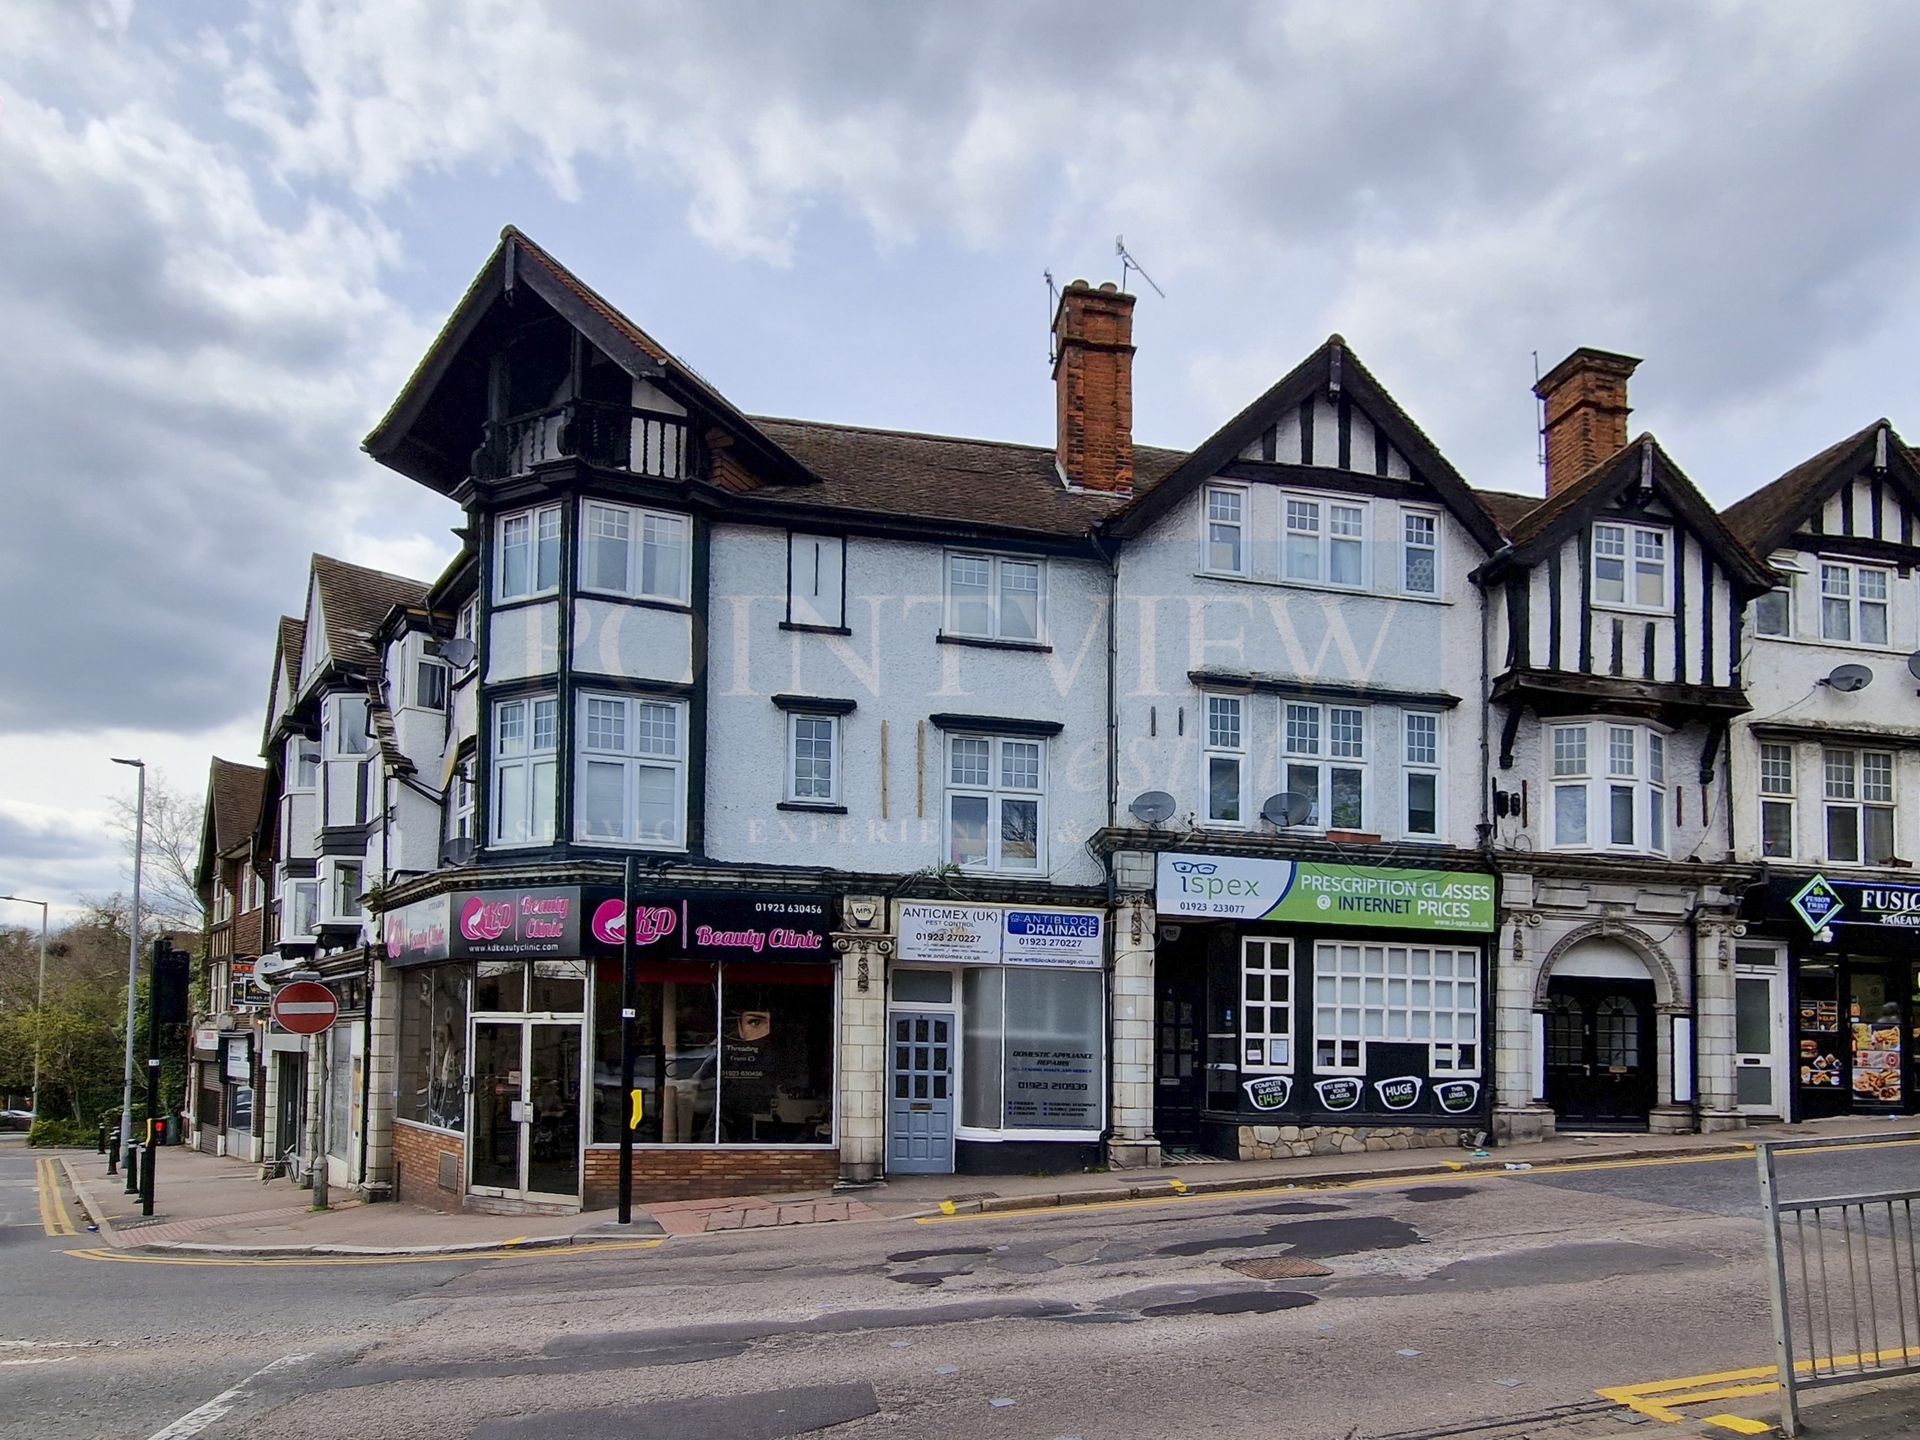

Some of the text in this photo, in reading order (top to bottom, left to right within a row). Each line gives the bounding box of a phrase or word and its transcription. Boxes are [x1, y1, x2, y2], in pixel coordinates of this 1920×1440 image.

[1301, 875, 1490, 901] PRESCRIPTION GLASSES
[522, 895, 569, 919] Beauty
[755, 903, 822, 914] 01923 630456
[1180, 901, 1245, 913] 01923 233077
[1338, 896, 1411, 914] INTERNET
[1417, 900, 1471, 918] PRICES
[636, 907, 677, 936] KD
[903, 907, 998, 924] ANTICMEX (UK)
[1024, 914, 1098, 926] ANTIBLOCK
[525, 917, 564, 938] Clinic
[1026, 923, 1097, 937] DRAINAGE
[696, 925, 822, 952] Beauty Clinic
[916, 933, 981, 943] 01923 270227
[1019, 937, 1082, 947] 01923 270227
[1018, 1081, 1088, 1091] 01923 210939
[1385, 1083, 1414, 1097] HUGE
